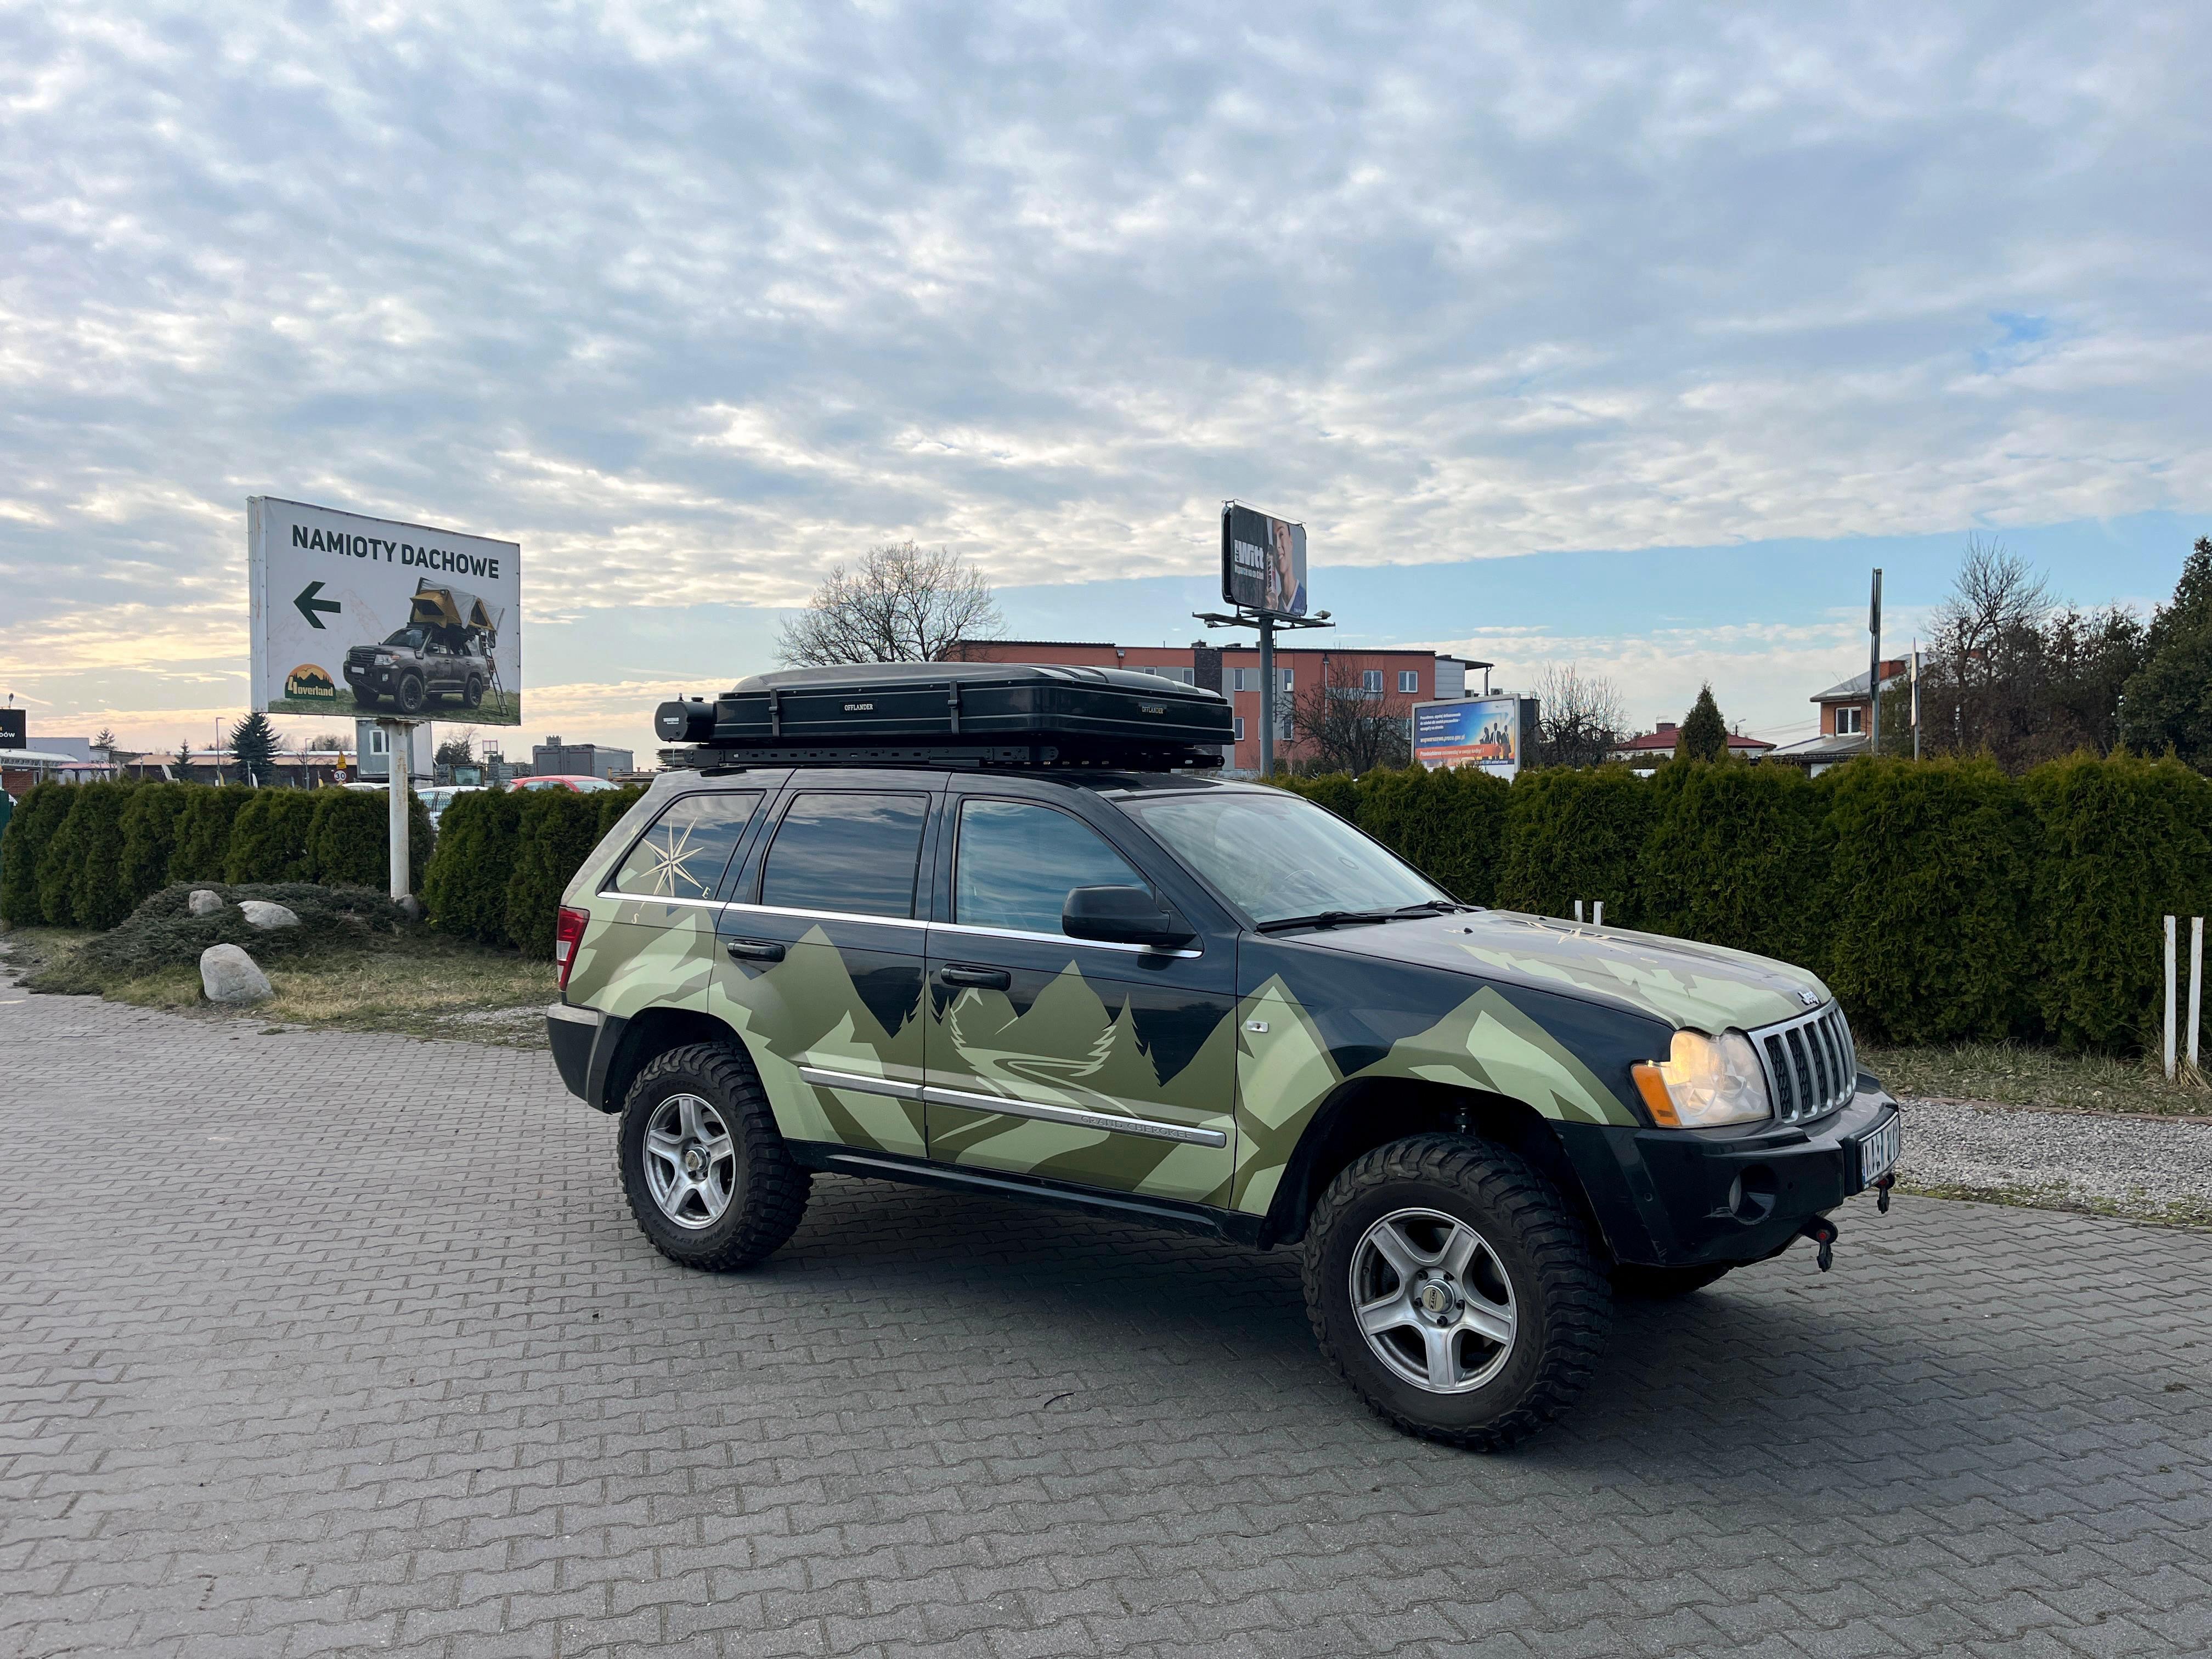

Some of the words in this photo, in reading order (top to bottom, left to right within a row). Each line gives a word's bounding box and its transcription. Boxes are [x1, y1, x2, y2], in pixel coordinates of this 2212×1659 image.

[292, 524, 397, 562] NAMIOTY
[401, 544, 499, 579] DACHOWE
[702, 886, 711, 899] E
[631, 913, 640, 924] S
[1798, 991, 1819, 1005] Jeep
[1081, 1115, 1122, 1129] GRAND
[1127, 1122, 1192, 1139] CHEROKEE
